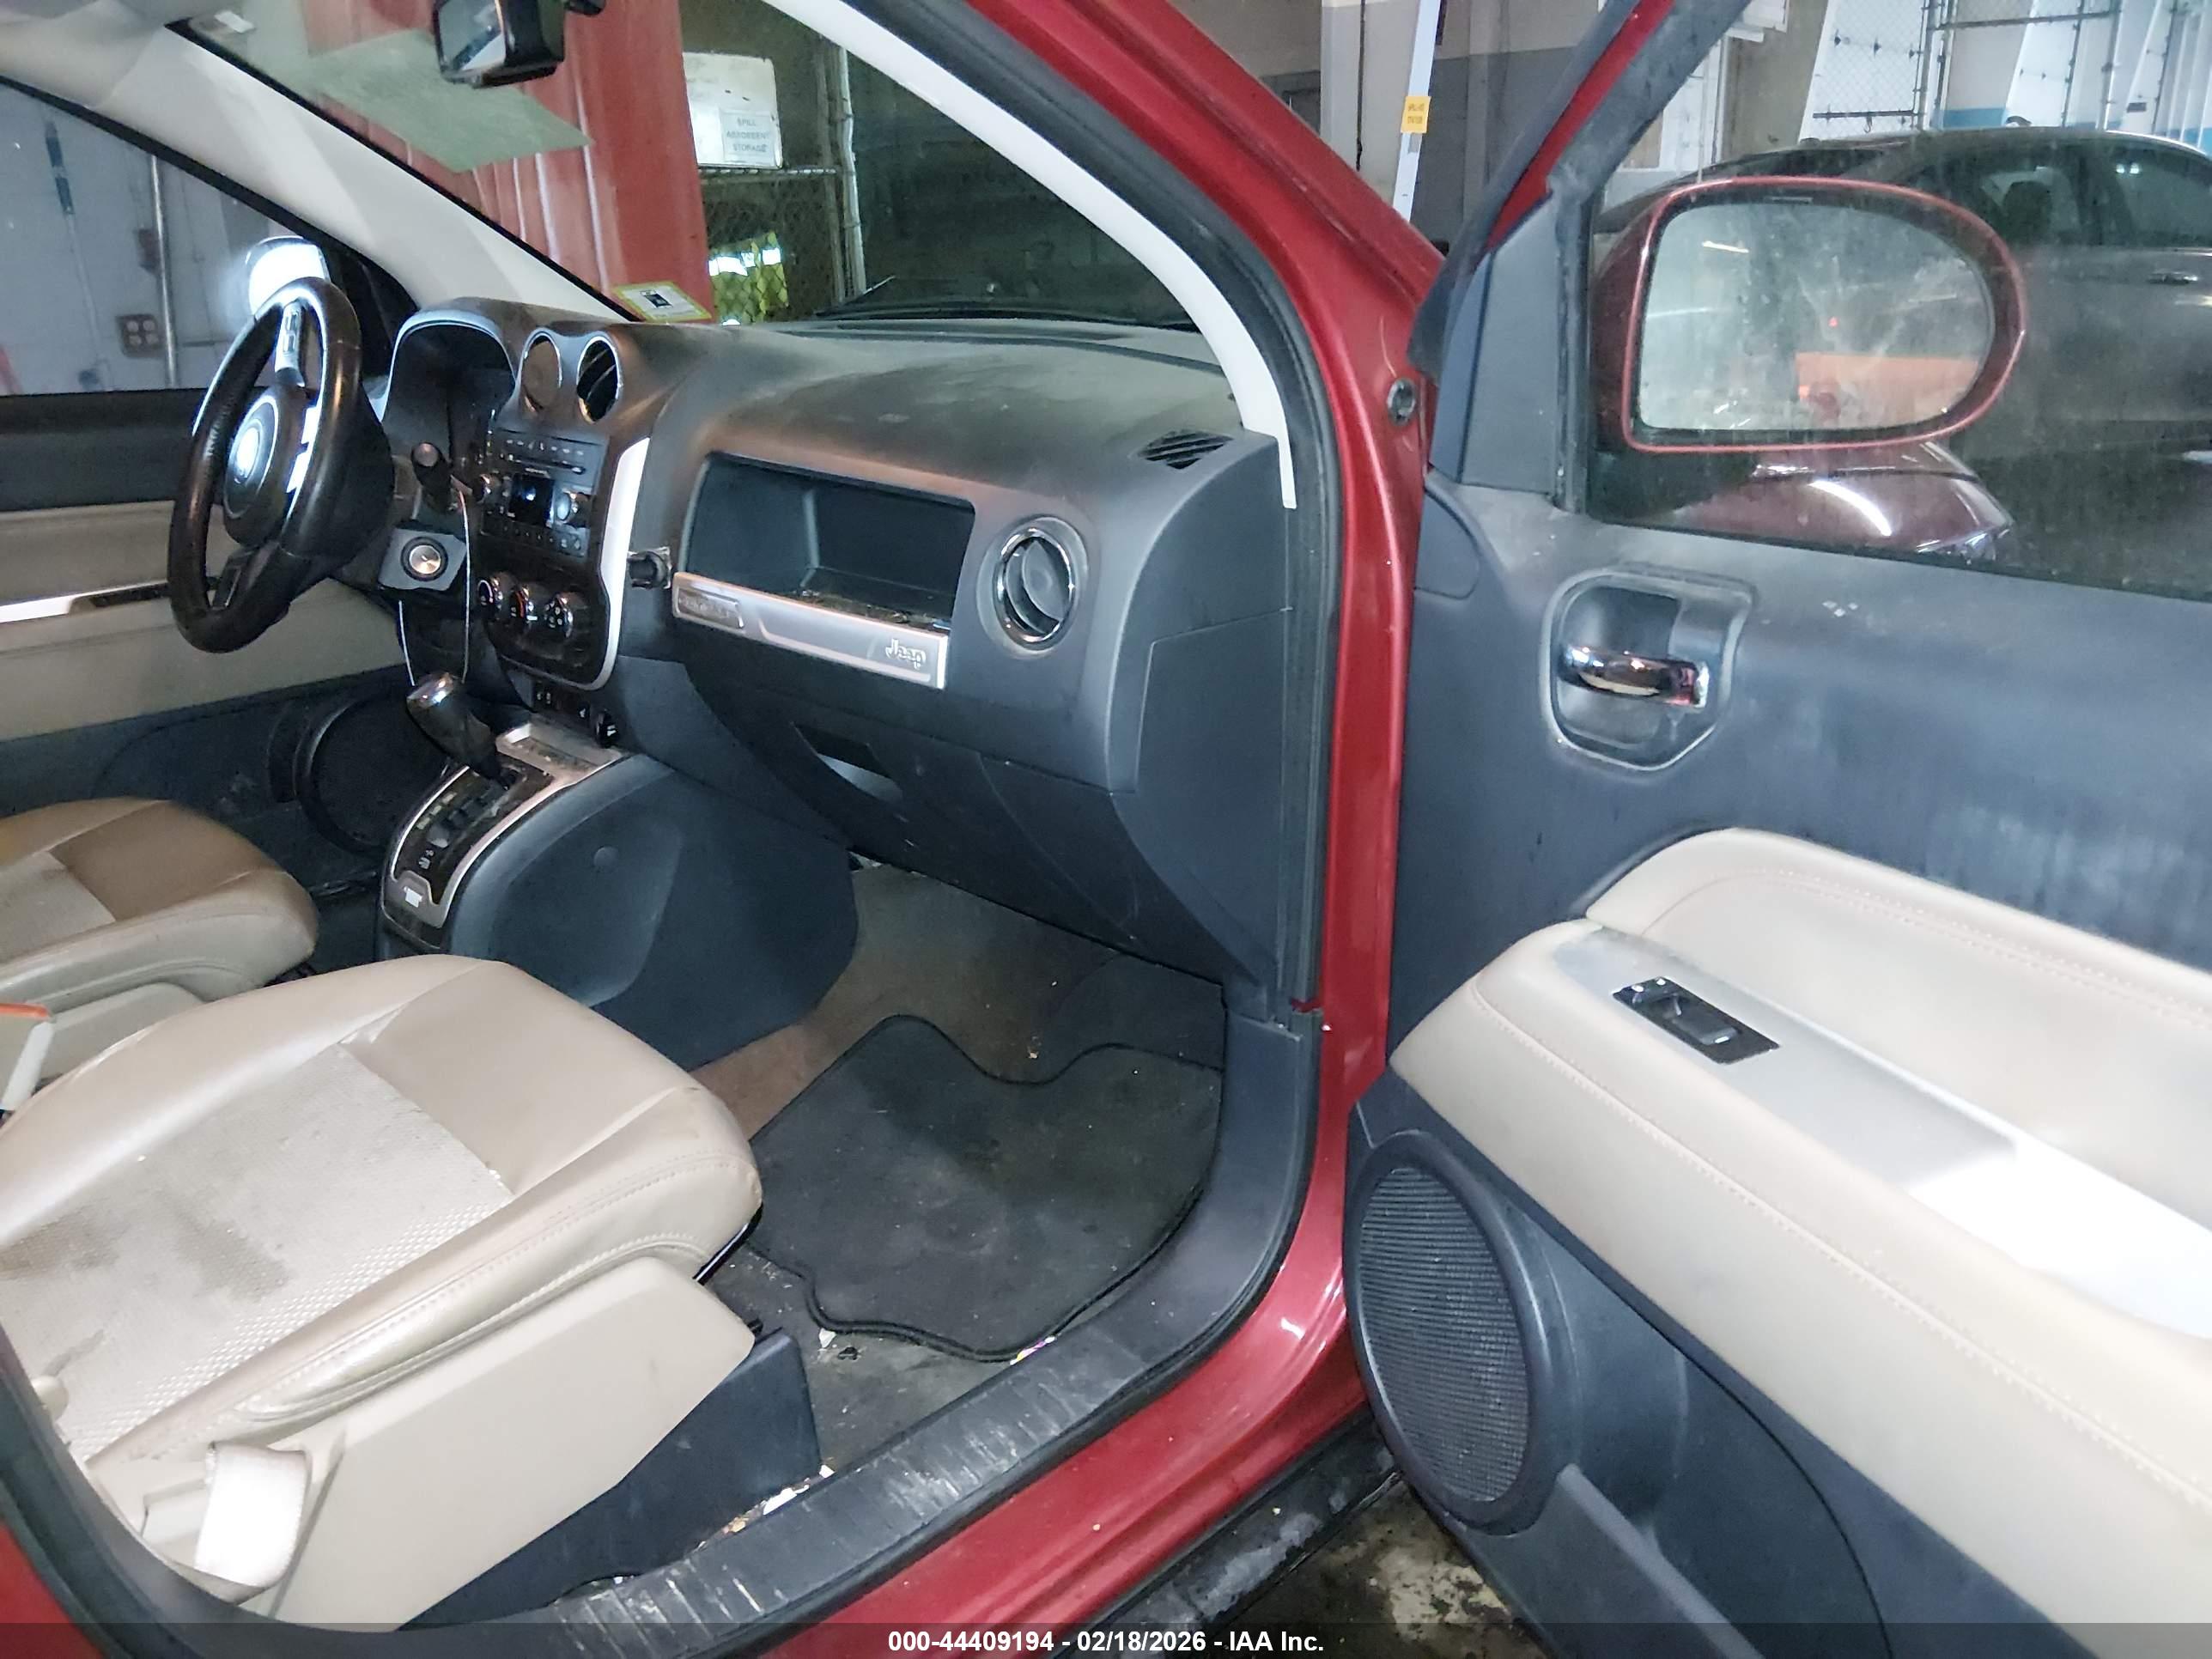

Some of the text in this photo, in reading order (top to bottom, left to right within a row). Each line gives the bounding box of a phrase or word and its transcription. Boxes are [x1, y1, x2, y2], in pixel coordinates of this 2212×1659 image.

[737, 117, 757, 126] SPILL
[732, 143, 768, 153] STORAGE
[885, 639, 927, 670] Jeep
